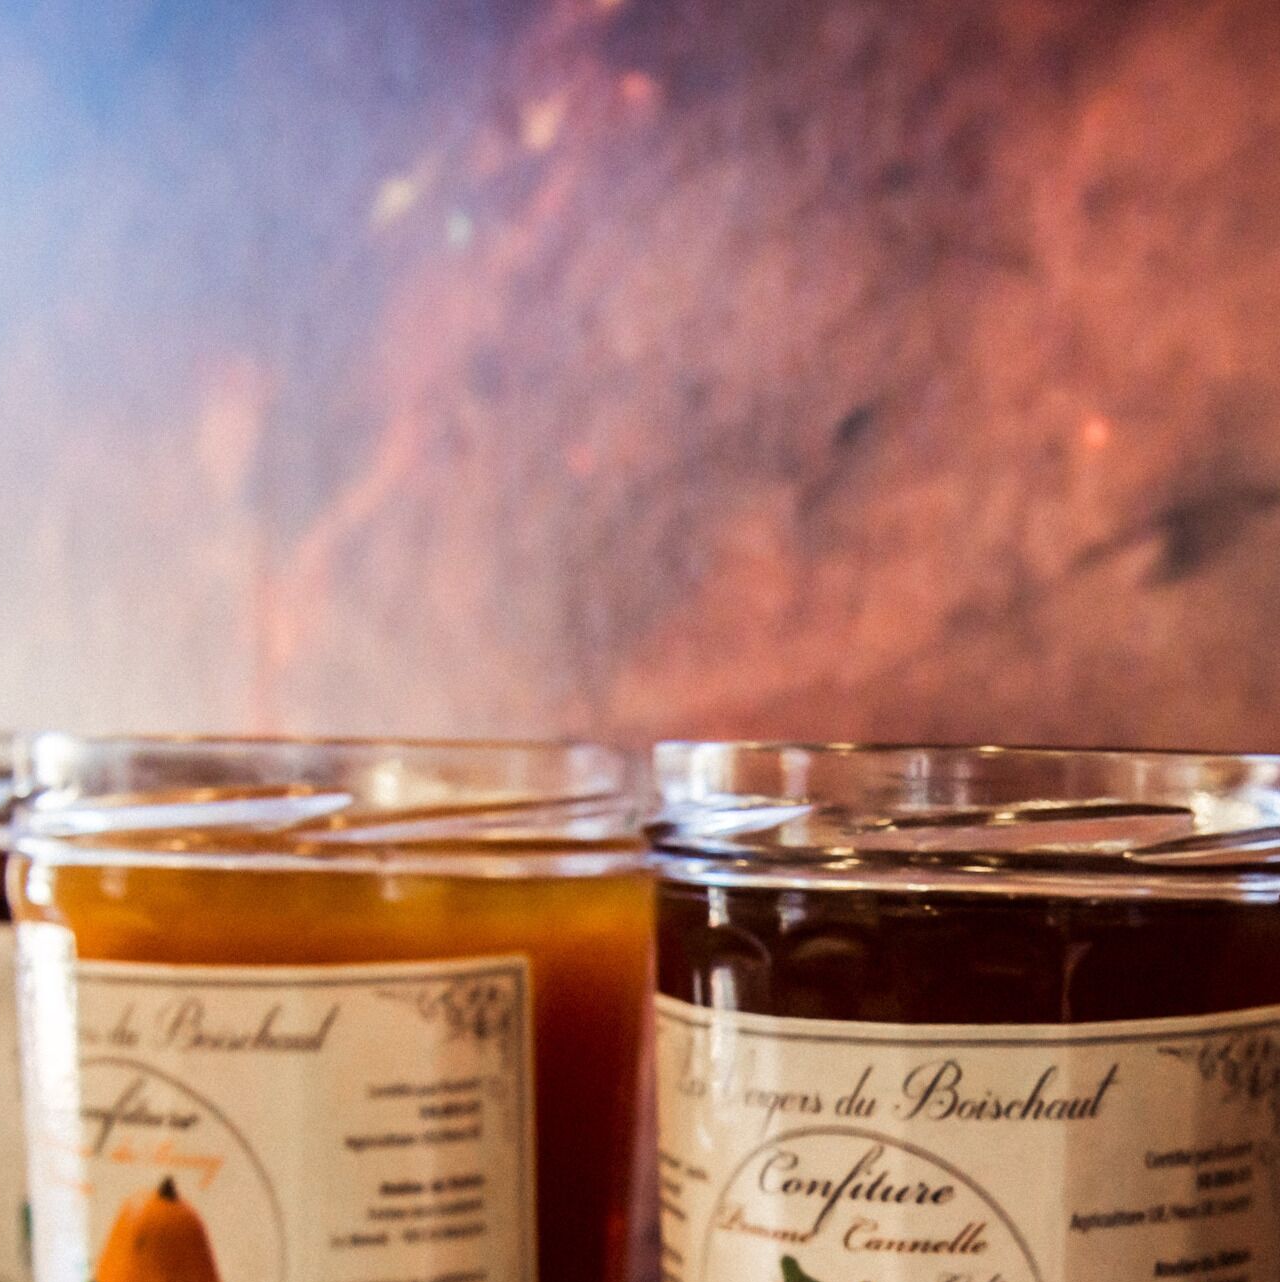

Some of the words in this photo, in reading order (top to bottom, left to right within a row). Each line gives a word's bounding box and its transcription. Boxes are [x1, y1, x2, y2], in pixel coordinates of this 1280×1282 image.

[834, 1066, 878, 1120] du
[894, 1058, 1119, 1122] Boischaut
[758, 1143, 957, 1237] Confiture
[843, 1218, 991, 1255] Cannelle
